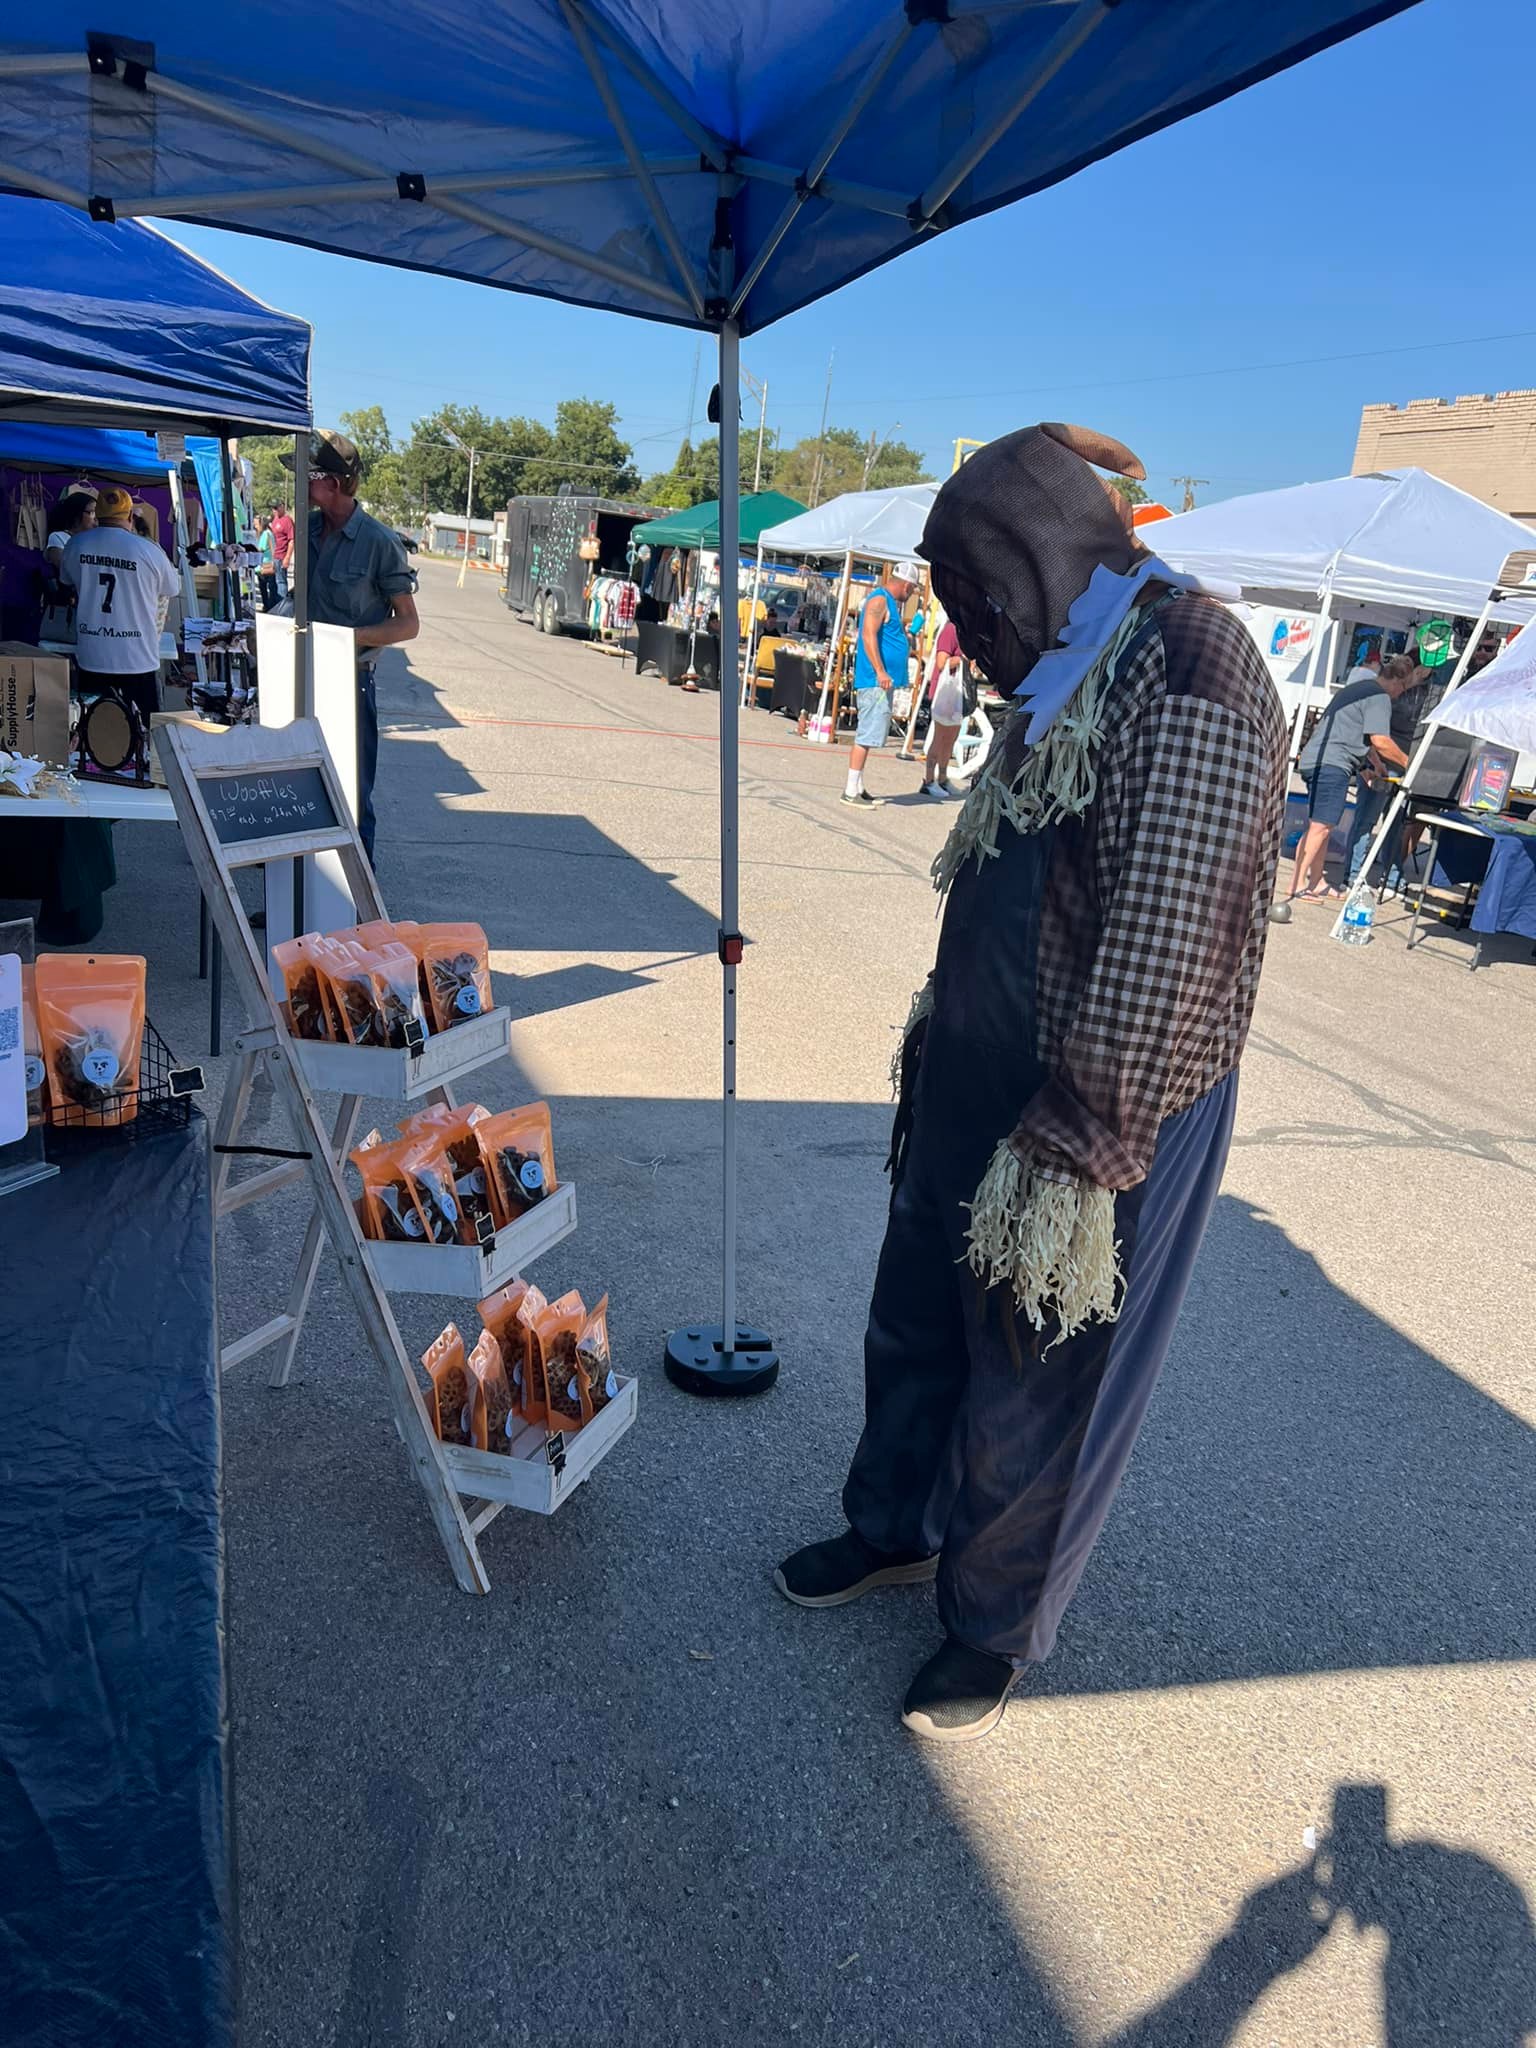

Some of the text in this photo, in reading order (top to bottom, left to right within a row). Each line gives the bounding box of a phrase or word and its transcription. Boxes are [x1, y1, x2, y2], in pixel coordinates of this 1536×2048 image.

[79, 553, 137, 571] COLMENARES
[98, 573, 116, 613] 7
[103, 626, 142, 638] MADRID
